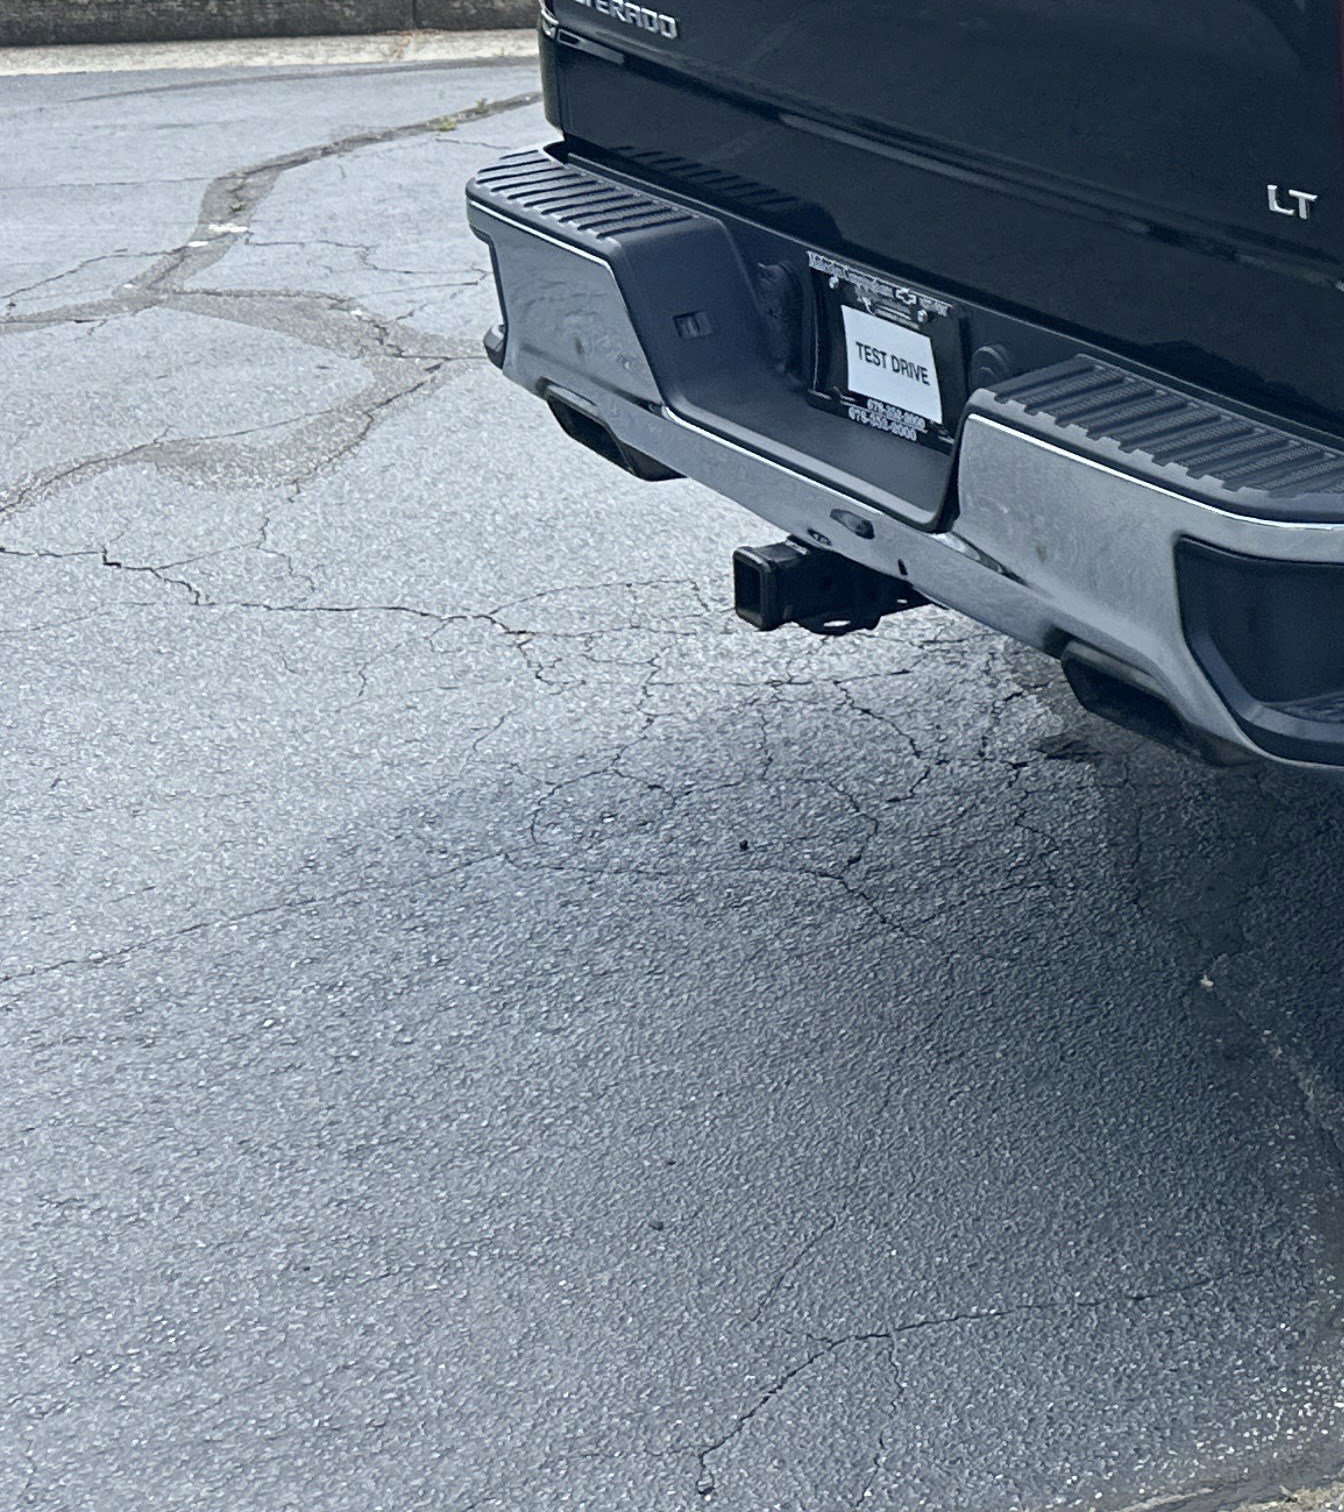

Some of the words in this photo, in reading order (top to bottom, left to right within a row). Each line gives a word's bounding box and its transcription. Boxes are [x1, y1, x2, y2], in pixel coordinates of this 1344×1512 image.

[1267, 184, 1318, 220] LT
[855, 341, 887, 369] TEST
[890, 354, 931, 386] DRIVE
